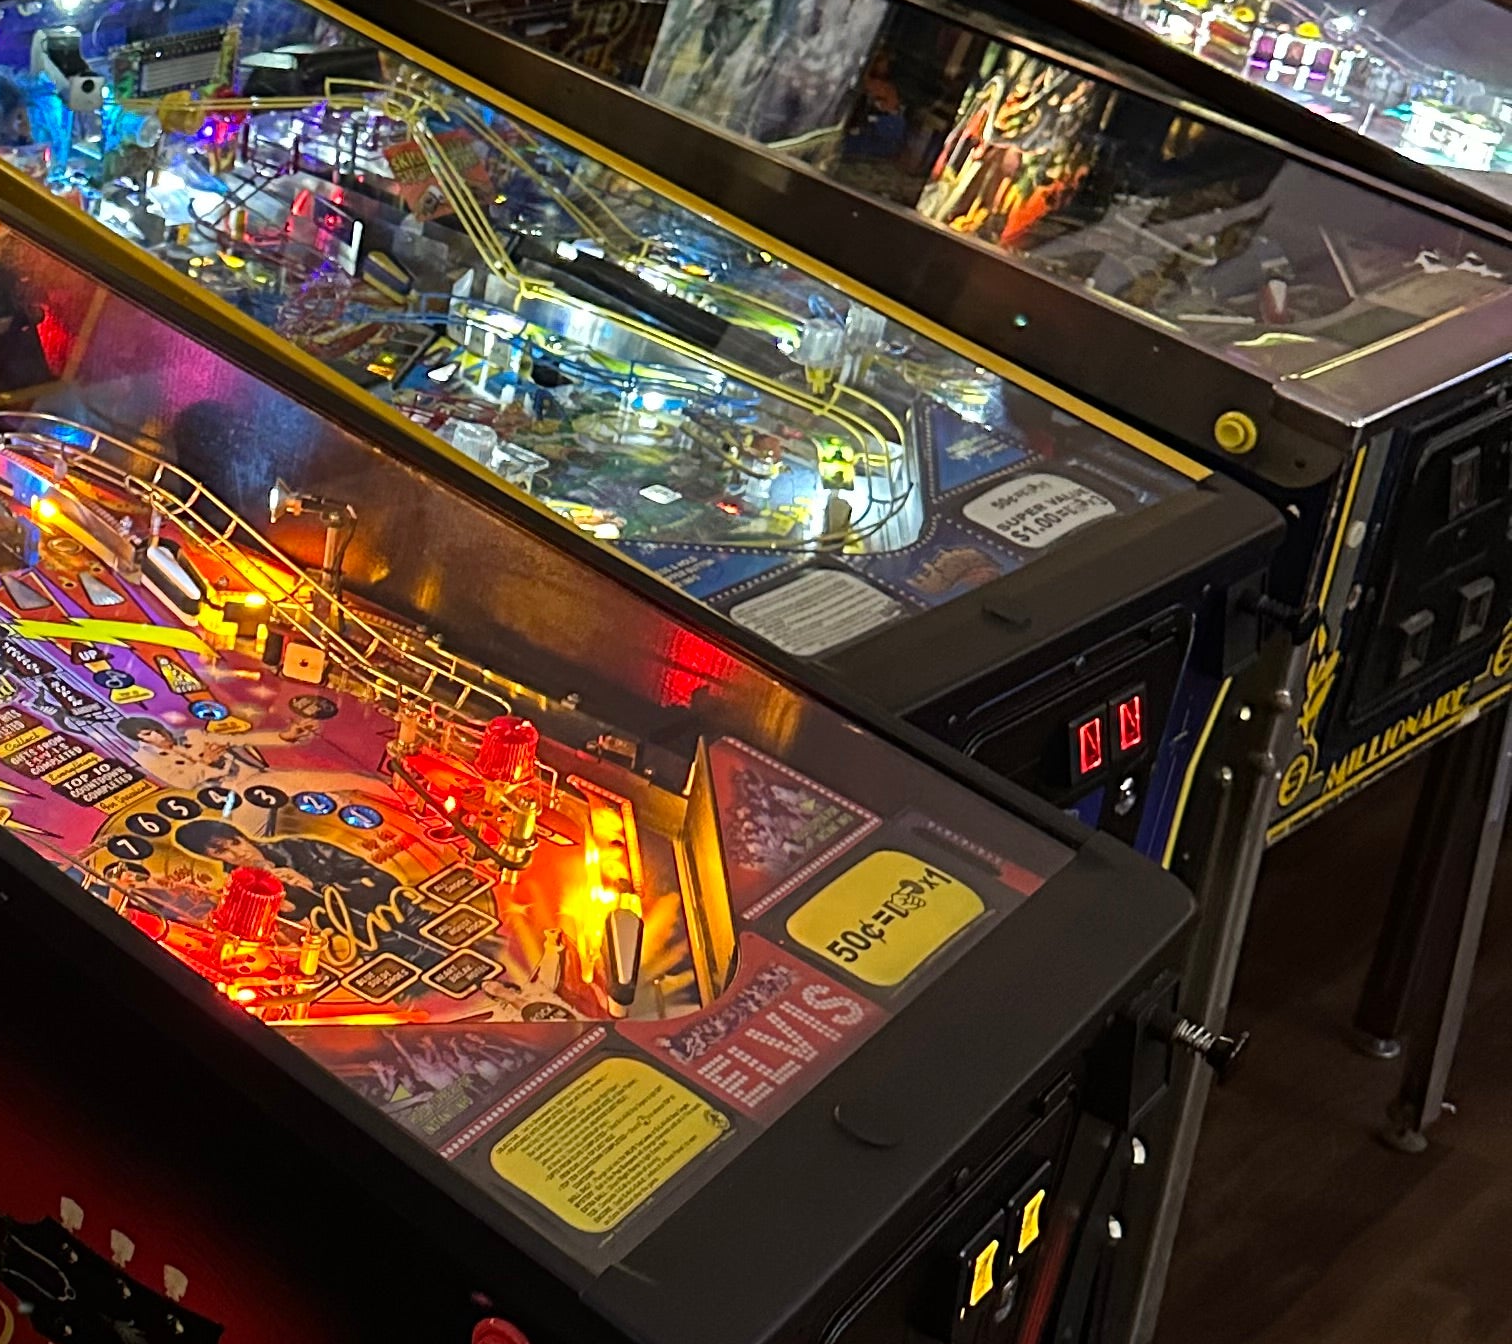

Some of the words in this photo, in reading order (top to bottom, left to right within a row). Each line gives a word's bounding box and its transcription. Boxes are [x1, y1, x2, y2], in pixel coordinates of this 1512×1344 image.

[997, 503, 1046, 533] SUPER
[29, 745, 84, 776] COMPLETED
[62, 771, 92, 791] TOP
[93, 762, 112, 777] 10
[69, 765, 127, 800] COUNTDOWN
[82, 772, 135, 803] COMPLETED
[115, 837, 140, 857] 7
[137, 814, 161, 834] 6
[169, 798, 189, 818] 5
[206, 789, 228, 804] 4
[253, 787, 276, 806] 3
[303, 794, 325, 811] 2
[351, 810, 374, 825] 1
[697, 983, 864, 1108] ELVIS
